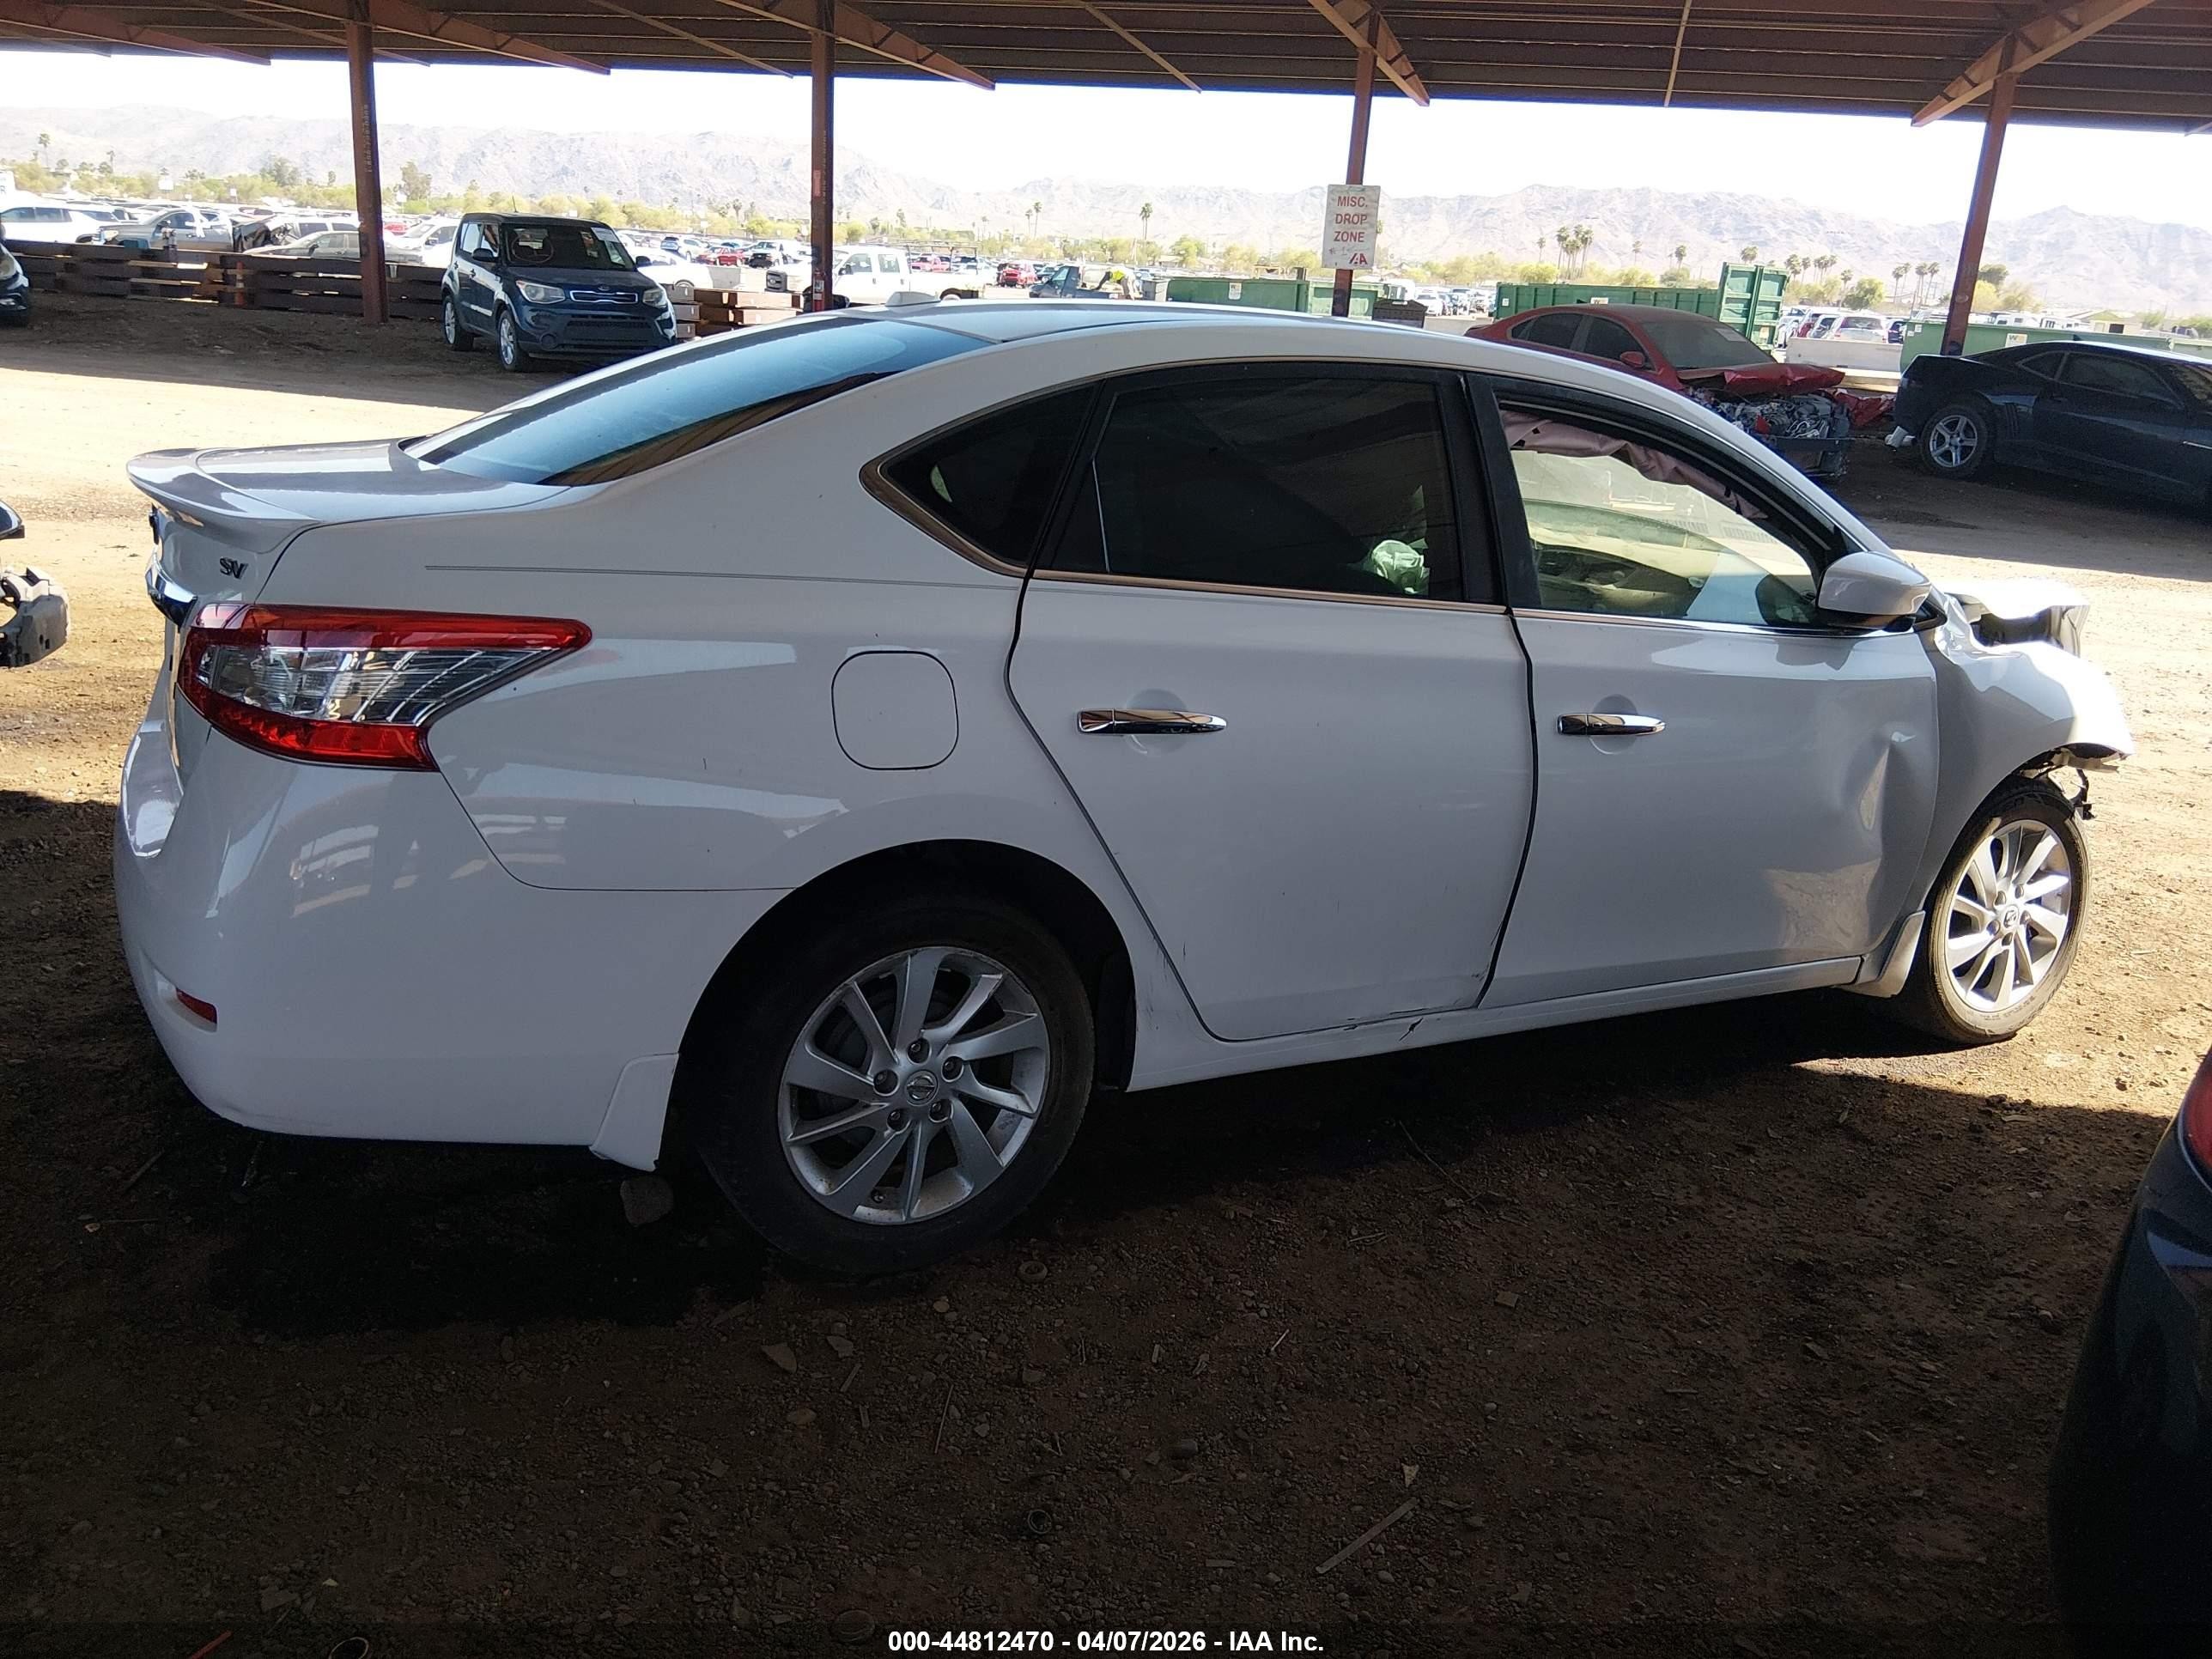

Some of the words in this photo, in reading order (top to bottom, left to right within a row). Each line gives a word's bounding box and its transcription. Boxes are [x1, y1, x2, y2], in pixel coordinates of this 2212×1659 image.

[1337, 196, 1368, 208] MISC.
[1335, 213, 1367, 225] DROP
[1334, 231, 1364, 242] ZONE
[220, 557, 249, 580] SV
